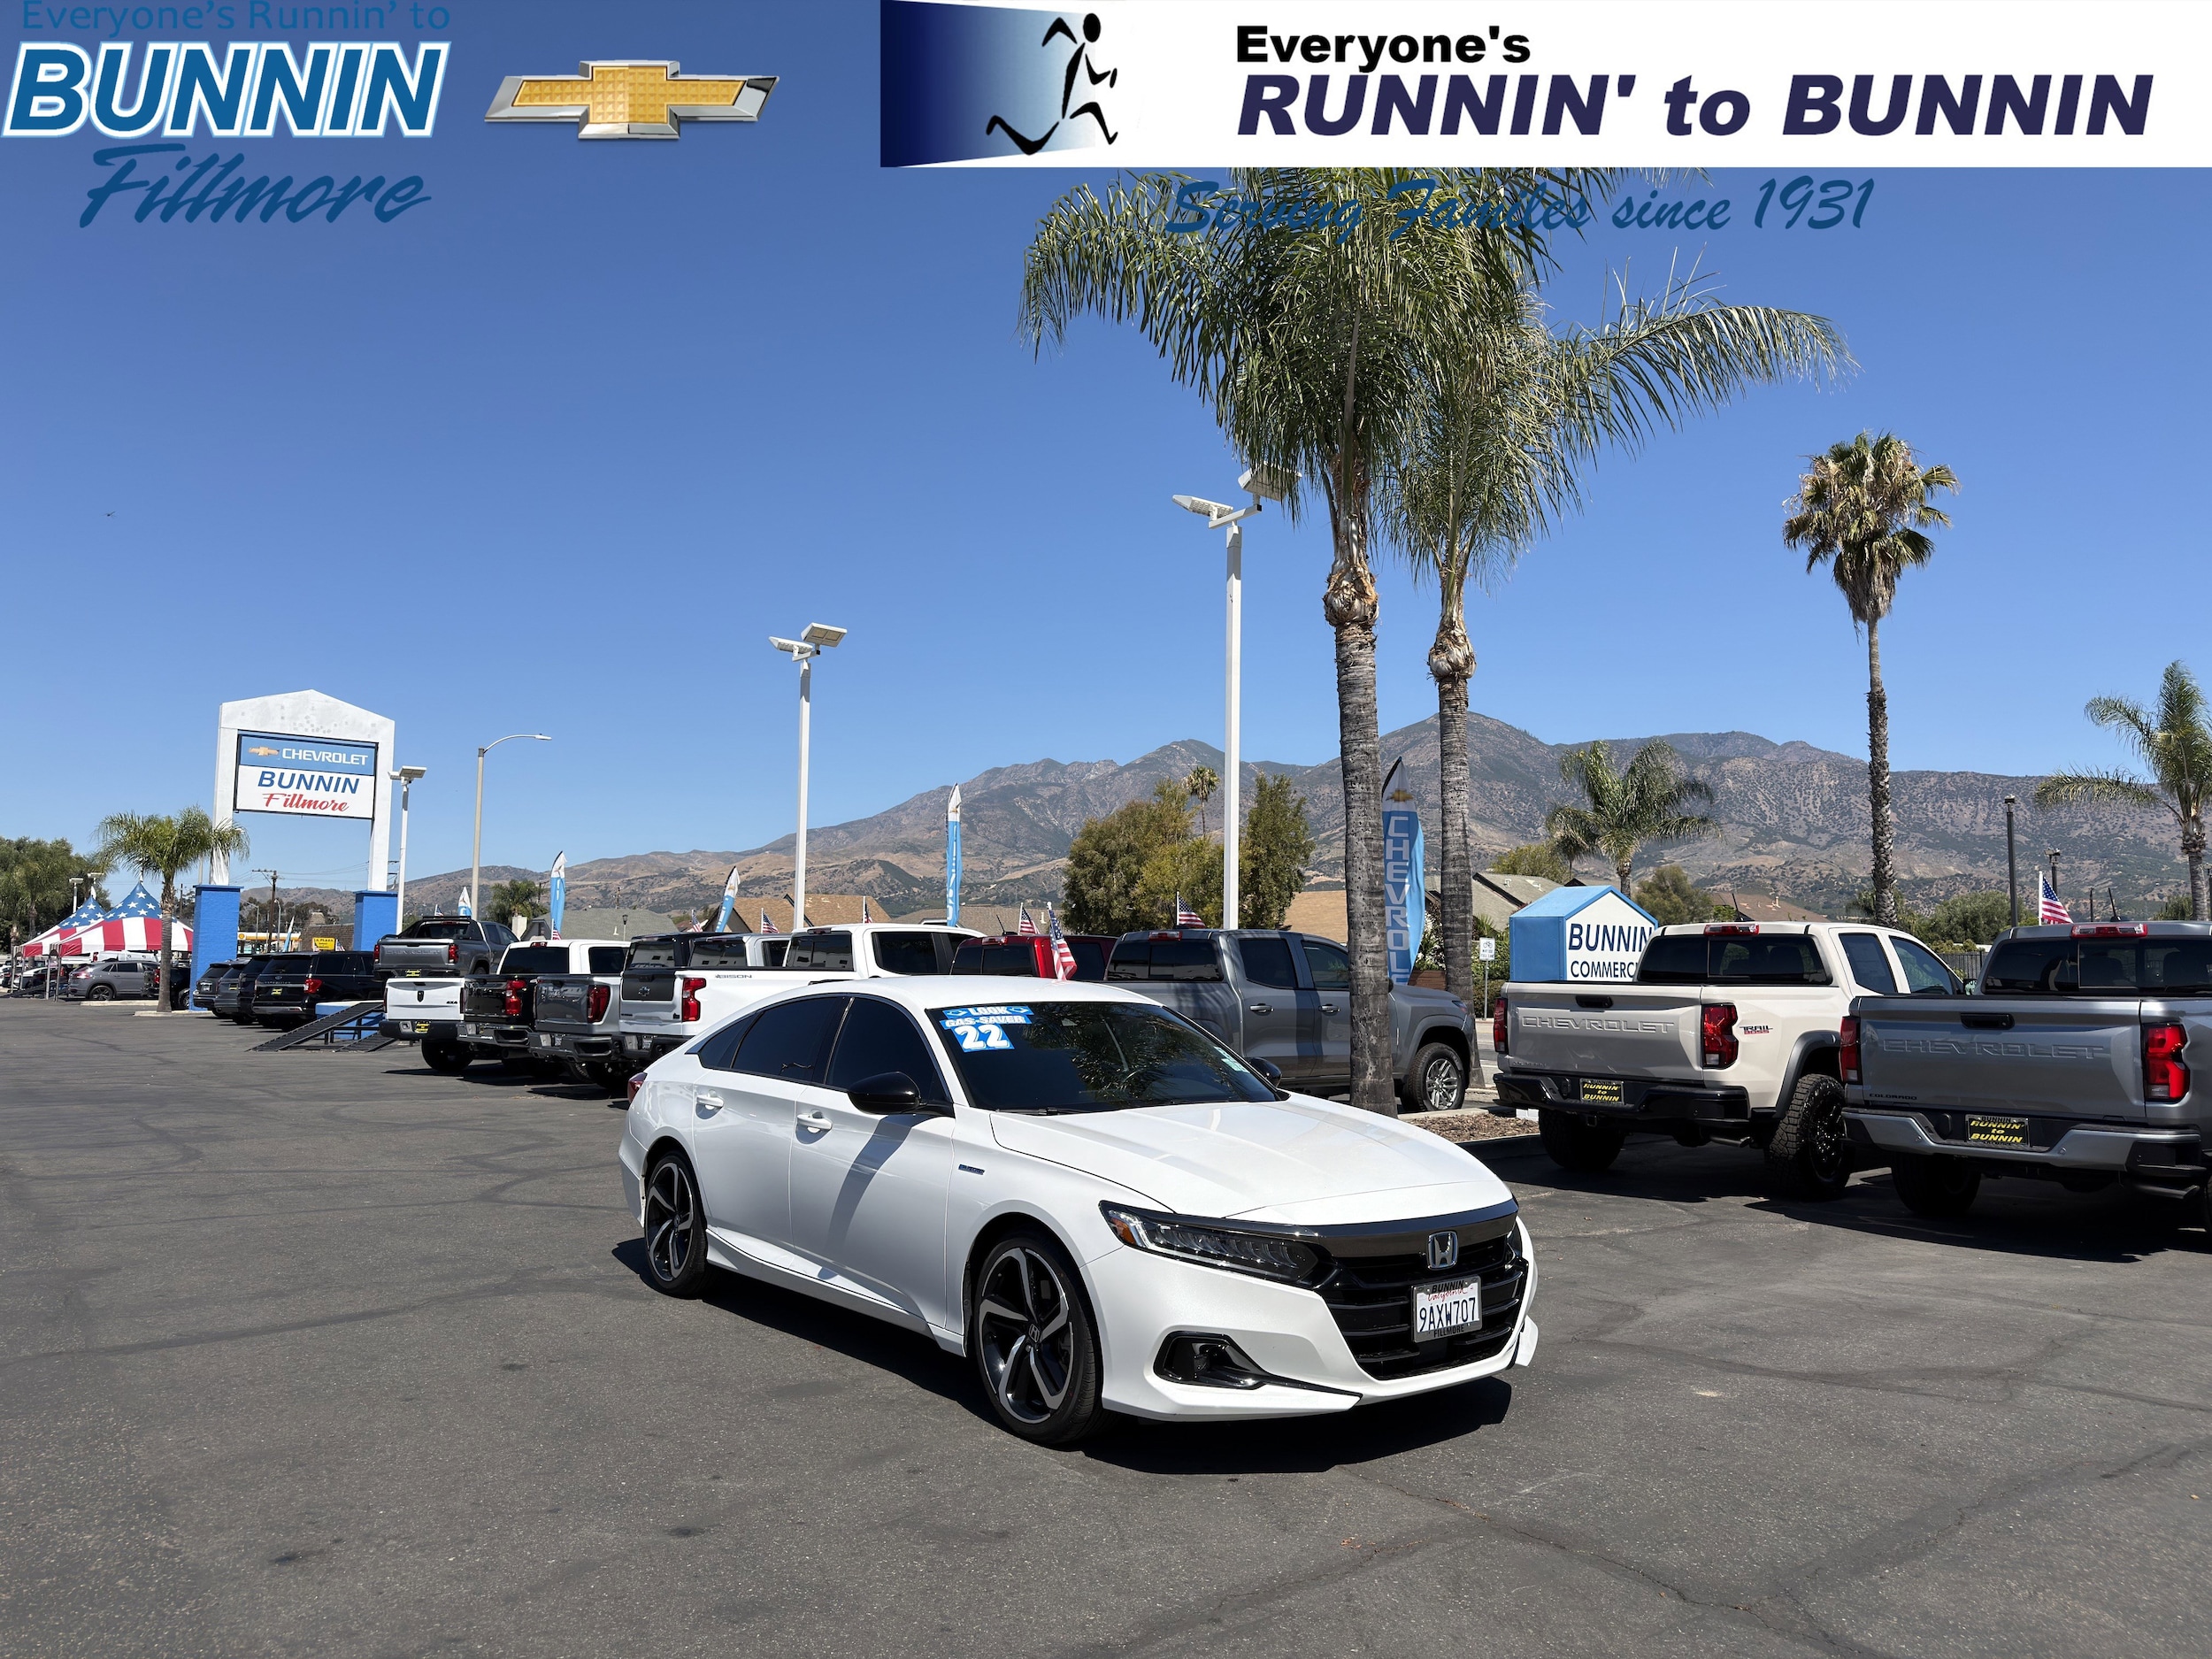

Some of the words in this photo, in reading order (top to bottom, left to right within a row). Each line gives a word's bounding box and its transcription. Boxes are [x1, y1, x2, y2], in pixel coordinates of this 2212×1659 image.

[281, 747, 369, 765] CHEVROLET
[257, 771, 360, 795] BUNNIN
[262, 793, 350, 812] Fillmore
[1568, 923, 1653, 953] BUNNIN
[969, 1006, 1012, 1016] LOOK
[945, 1015, 1026, 1028] GAS-SAVER
[1521, 1016, 1675, 1033] CHEVROLET
[954, 1024, 1010, 1050] 22
[1883, 1038, 2104, 1060] CHEVROLET
[1970, 1133, 2024, 1143] BUNNIN
[1432, 1280, 1464, 1294] BUNNIN
[1419, 1296, 1477, 1333] 9AXW707
[1433, 1324, 1465, 1338] FILLMORE
